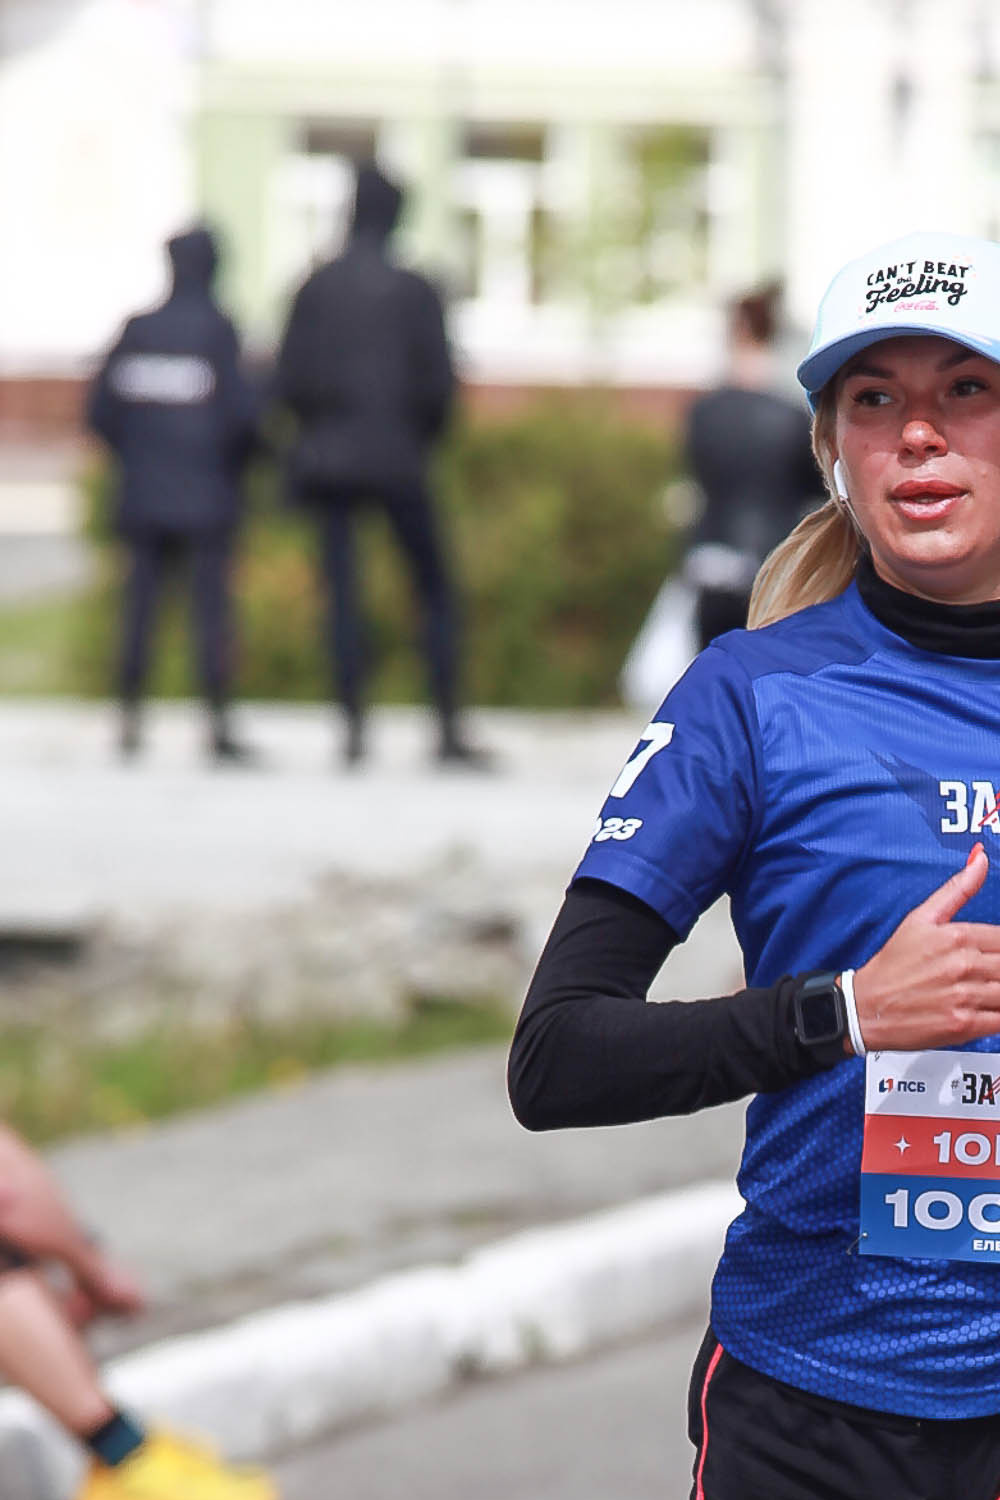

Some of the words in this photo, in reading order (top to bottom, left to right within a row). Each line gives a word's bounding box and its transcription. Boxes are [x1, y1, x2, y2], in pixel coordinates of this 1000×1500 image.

[867, 261, 917, 286] CAN'T
[923, 260, 969, 278] BEAT
[865, 273, 968, 313] Feeling
[897, 1080, 926, 1093] ПСБ
